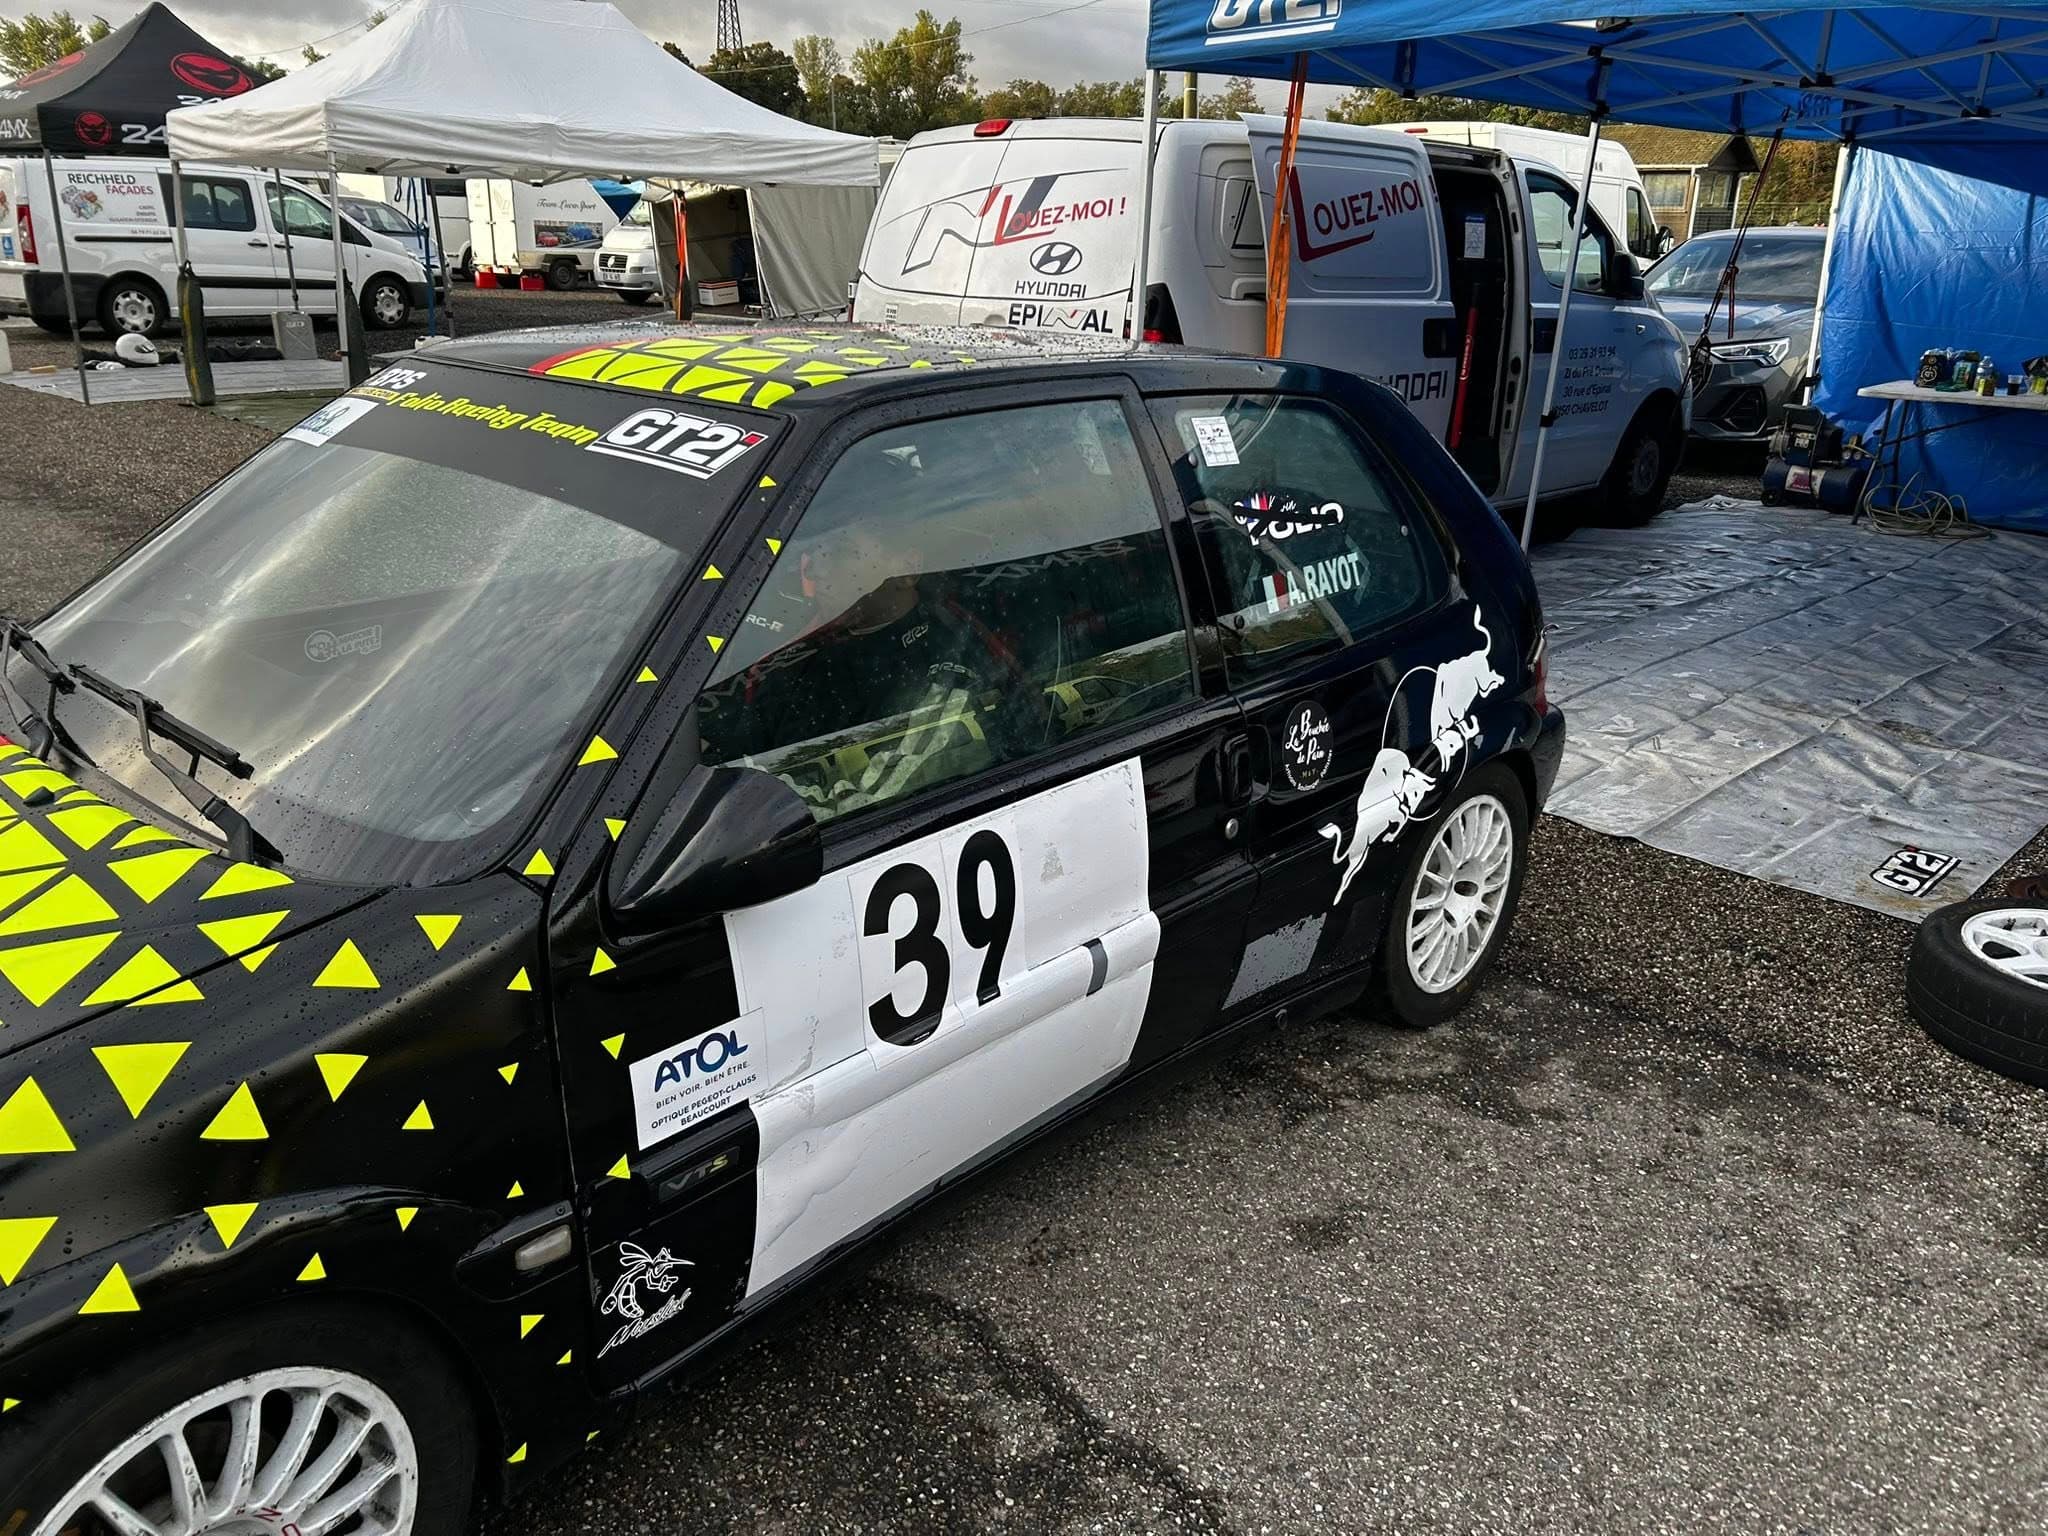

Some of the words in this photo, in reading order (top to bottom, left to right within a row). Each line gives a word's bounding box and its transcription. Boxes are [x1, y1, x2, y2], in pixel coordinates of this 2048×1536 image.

[67, 173, 136, 185] REICHHELD
[105, 185, 154, 195] FAÇADES
[1014, 280, 1087, 298] HYUNDAI
[1008, 303, 1113, 333] EPINAL
[437, 398, 528, 430] Racing
[519, 412, 599, 446] Team
[602, 409, 762, 474] GT2i
[1306, 737, 1325, 765] Pain
[1869, 846, 1955, 893] GT2i
[863, 829, 1017, 1047] 39
[654, 1030, 749, 1093] ATOL
[651, 1106, 690, 1129] OPTIQUE
[691, 1074, 757, 1111] PEGEOT-CLAUSS
[656, 1094, 677, 1109] BIEN
[680, 1083, 703, 1098] VOIR.
[705, 1072, 725, 1087] BIEN
[681, 1096, 731, 1126] BEAUCOURT
[667, 1154, 729, 1190] VTS
